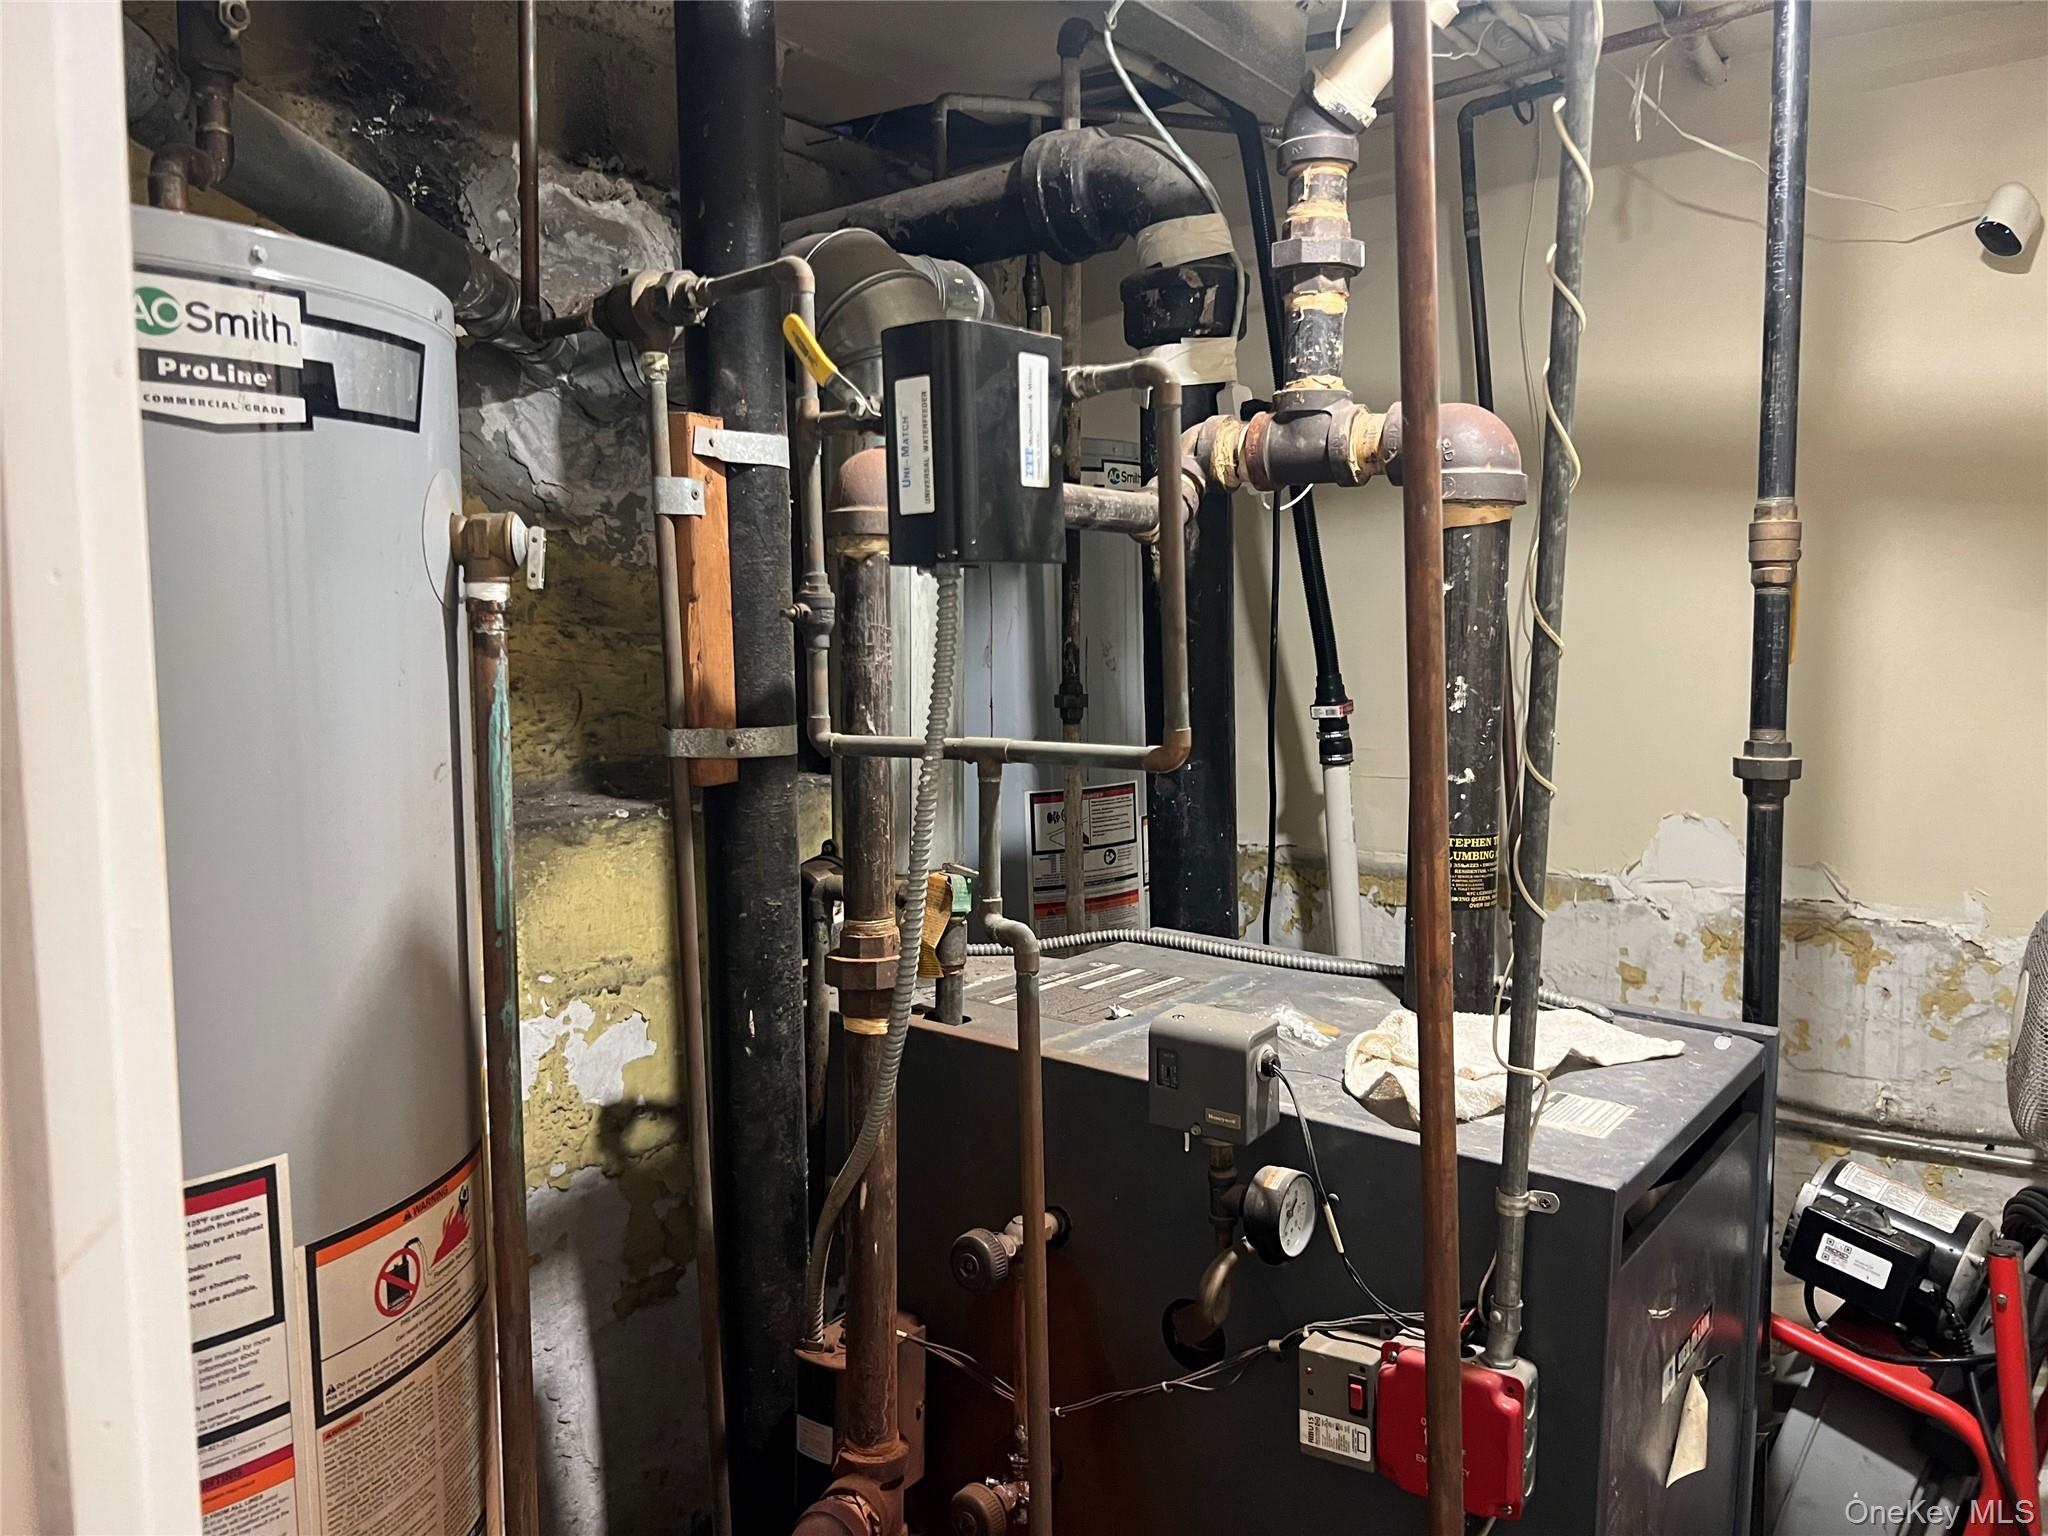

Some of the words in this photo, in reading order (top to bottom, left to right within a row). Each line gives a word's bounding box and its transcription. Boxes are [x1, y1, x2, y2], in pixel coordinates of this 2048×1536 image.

[185, 301, 293, 346] Smith
[156, 357, 268, 387] ProLine
[142, 393, 238, 411] COMMERCIAL
[244, 404, 286, 415] GRADE
[1449, 838, 1492, 847] TEPHEN
[1449, 850, 1494, 860] UMBING
